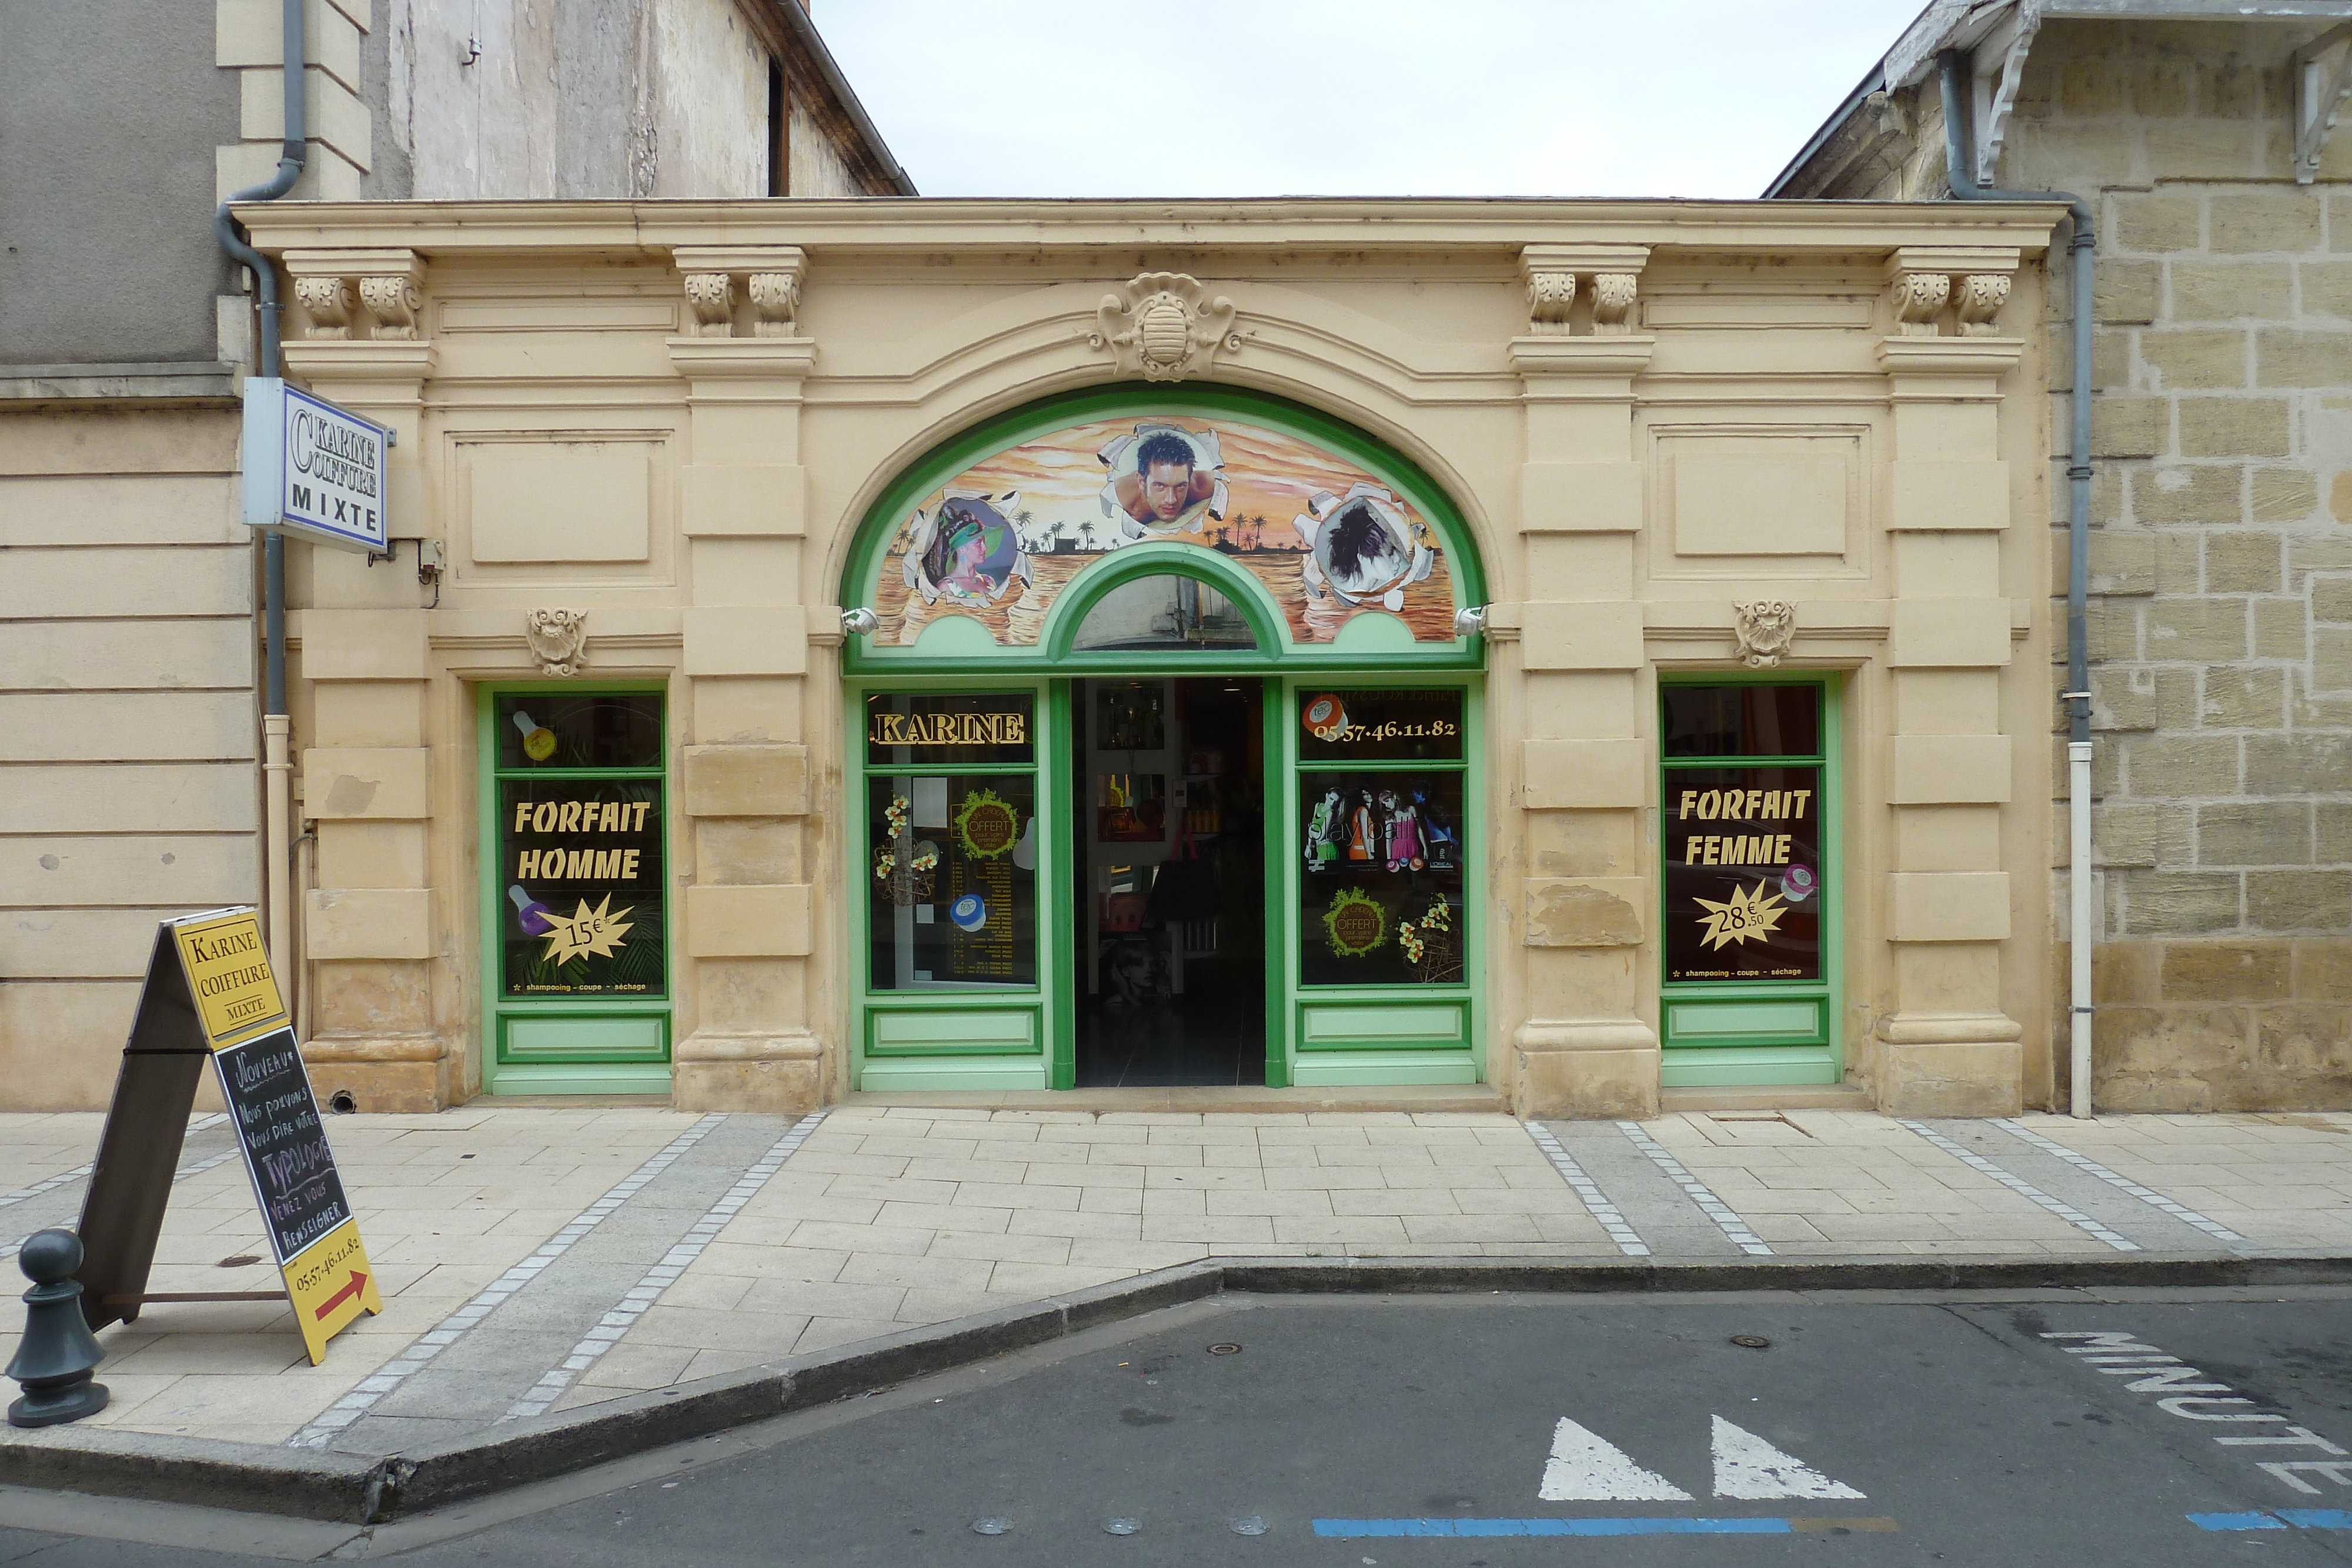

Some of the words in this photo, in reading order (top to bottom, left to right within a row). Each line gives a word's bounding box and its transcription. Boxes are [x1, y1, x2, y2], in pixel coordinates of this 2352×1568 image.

[315, 417, 375, 470] KARINE
[293, 484, 376, 531] MIXTE
[875, 713, 1024, 744] KARINE
[1314, 720, 1456, 742] 05.57.46.11.82
[515, 801, 650, 833] FORFAIT
[1679, 789, 1811, 820] FORFAIT
[969, 821, 1010, 831] OFFERT
[517, 848, 640, 879] HOMME
[1686, 835, 1792, 865] FEMME
[1337, 918, 1377, 930] OFFERT
[189, 931, 257, 964] KARINE
[200, 963, 269, 997] COIFFURE
[225, 998, 265, 1021] MIXTE
[295, 1111, 318, 1129] VOTRE
[262, 1135, 332, 1195] TYPOLOGIE
[270, 1198, 302, 1222] VENEZ
[305, 1182, 326, 1204] VOUS
[282, 1201, 342, 1251] RENSEIGNER
[297, 1238, 359, 1292] 05.57.46.11.82
